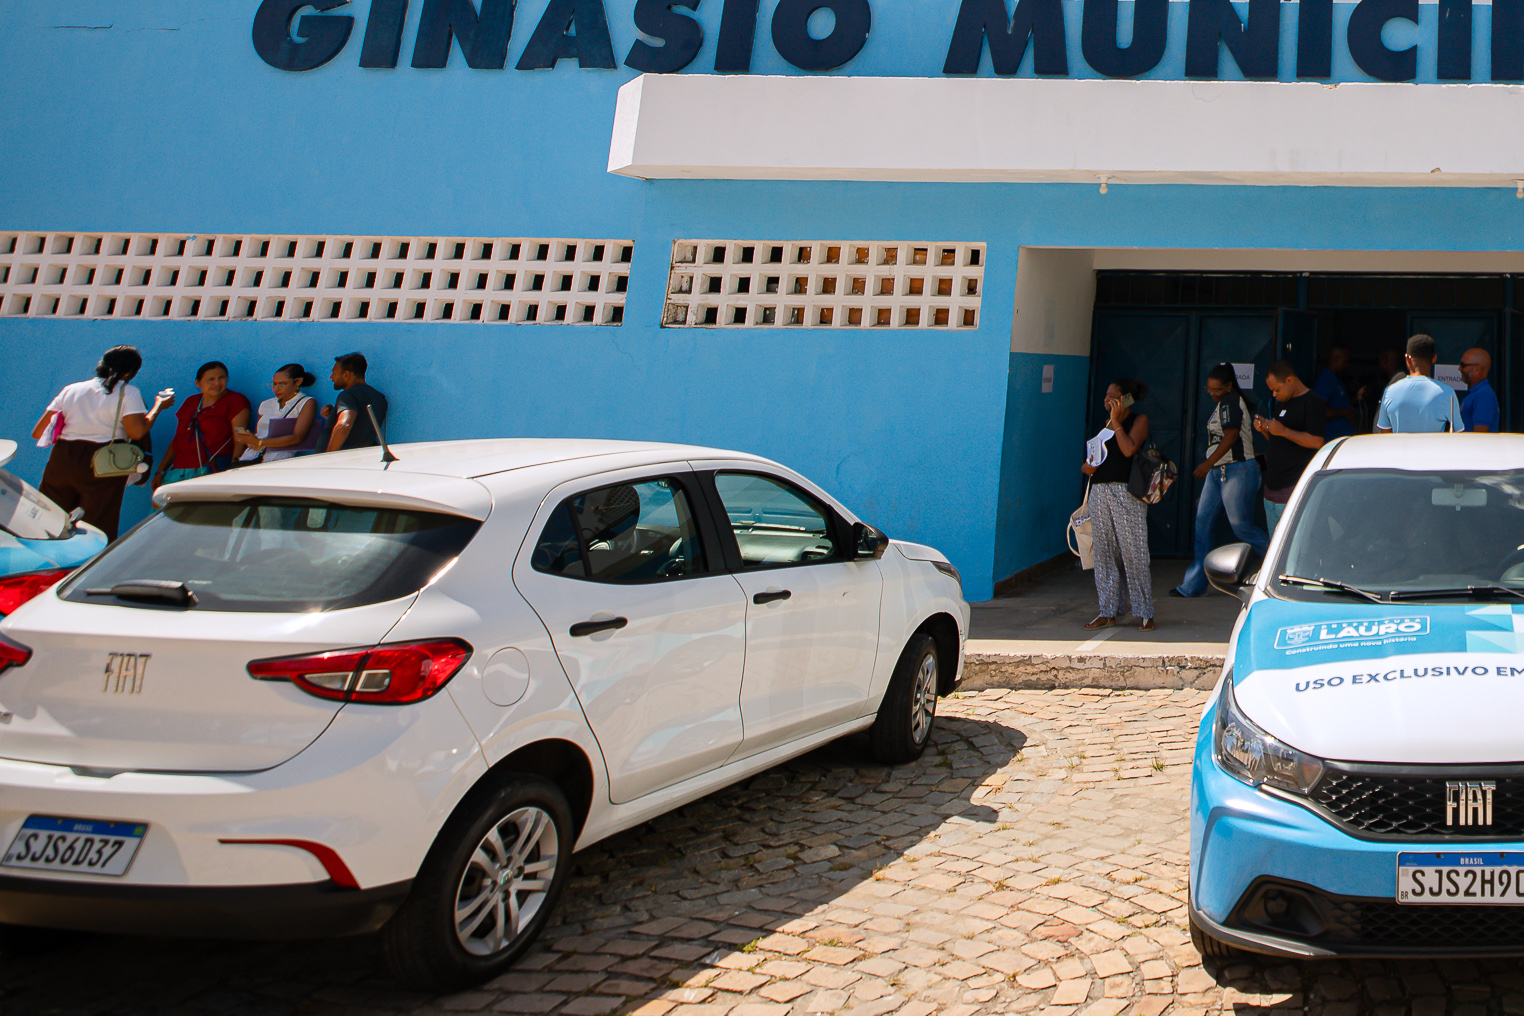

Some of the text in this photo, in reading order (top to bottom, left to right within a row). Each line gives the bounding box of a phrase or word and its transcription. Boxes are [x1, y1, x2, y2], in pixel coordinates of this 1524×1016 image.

[1319, 621, 1422, 640] LAURO
[1321, 618, 1421, 629] PREFEITURA
[1285, 643, 1338, 656] Construindo
[1383, 636, 1417, 645] história
[103, 652, 152, 694] FIAT
[1295, 676, 1345, 692] USO
[1351, 665, 1489, 686] EXCLUSIVO
[1446, 781, 1496, 826] FIAT
[15, 832, 126, 868] SJS6D37
[1460, 857, 1484, 865] BRASIL
[1400, 890, 1409, 900] BR
